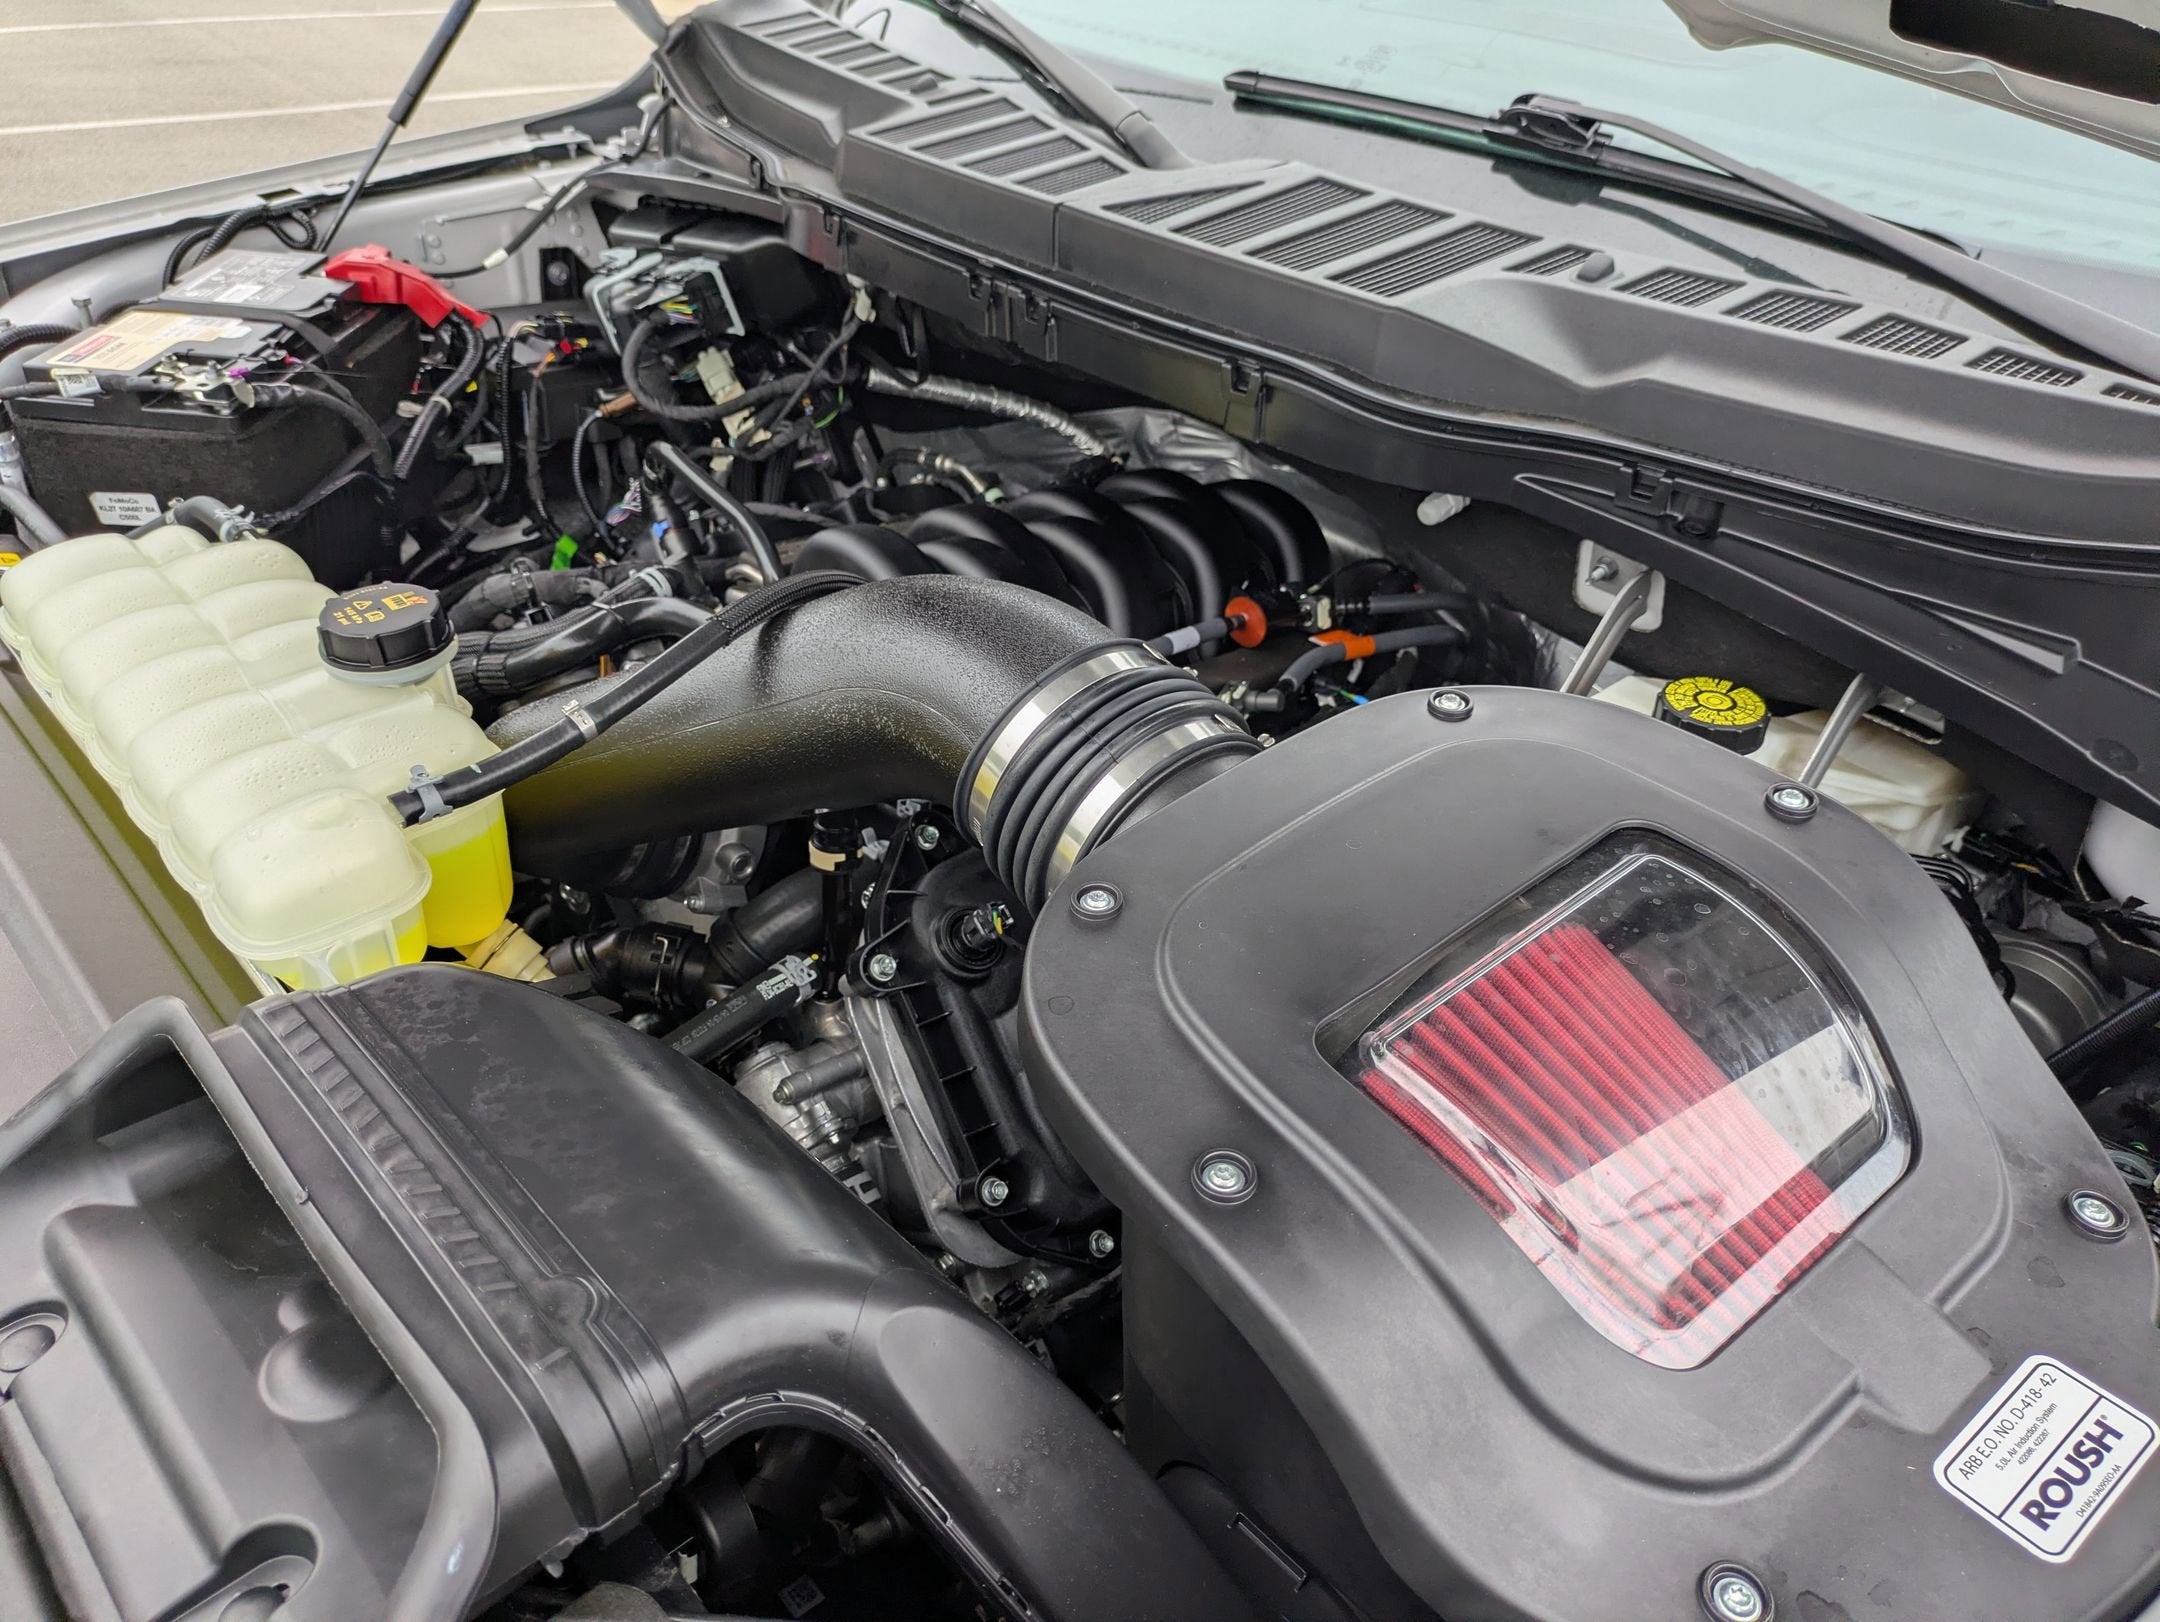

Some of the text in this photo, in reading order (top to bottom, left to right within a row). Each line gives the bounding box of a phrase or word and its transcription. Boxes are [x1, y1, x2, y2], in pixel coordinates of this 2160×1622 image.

[1958, 1456, 1984, 1481] ARB
[1976, 1437, 2002, 1459] E.O.
[1993, 1418, 2018, 1439] NO.
[1995, 1402, 2058, 1471] 5.0L Air Induction System
[2019, 1418, 2124, 1532] ROUSH
